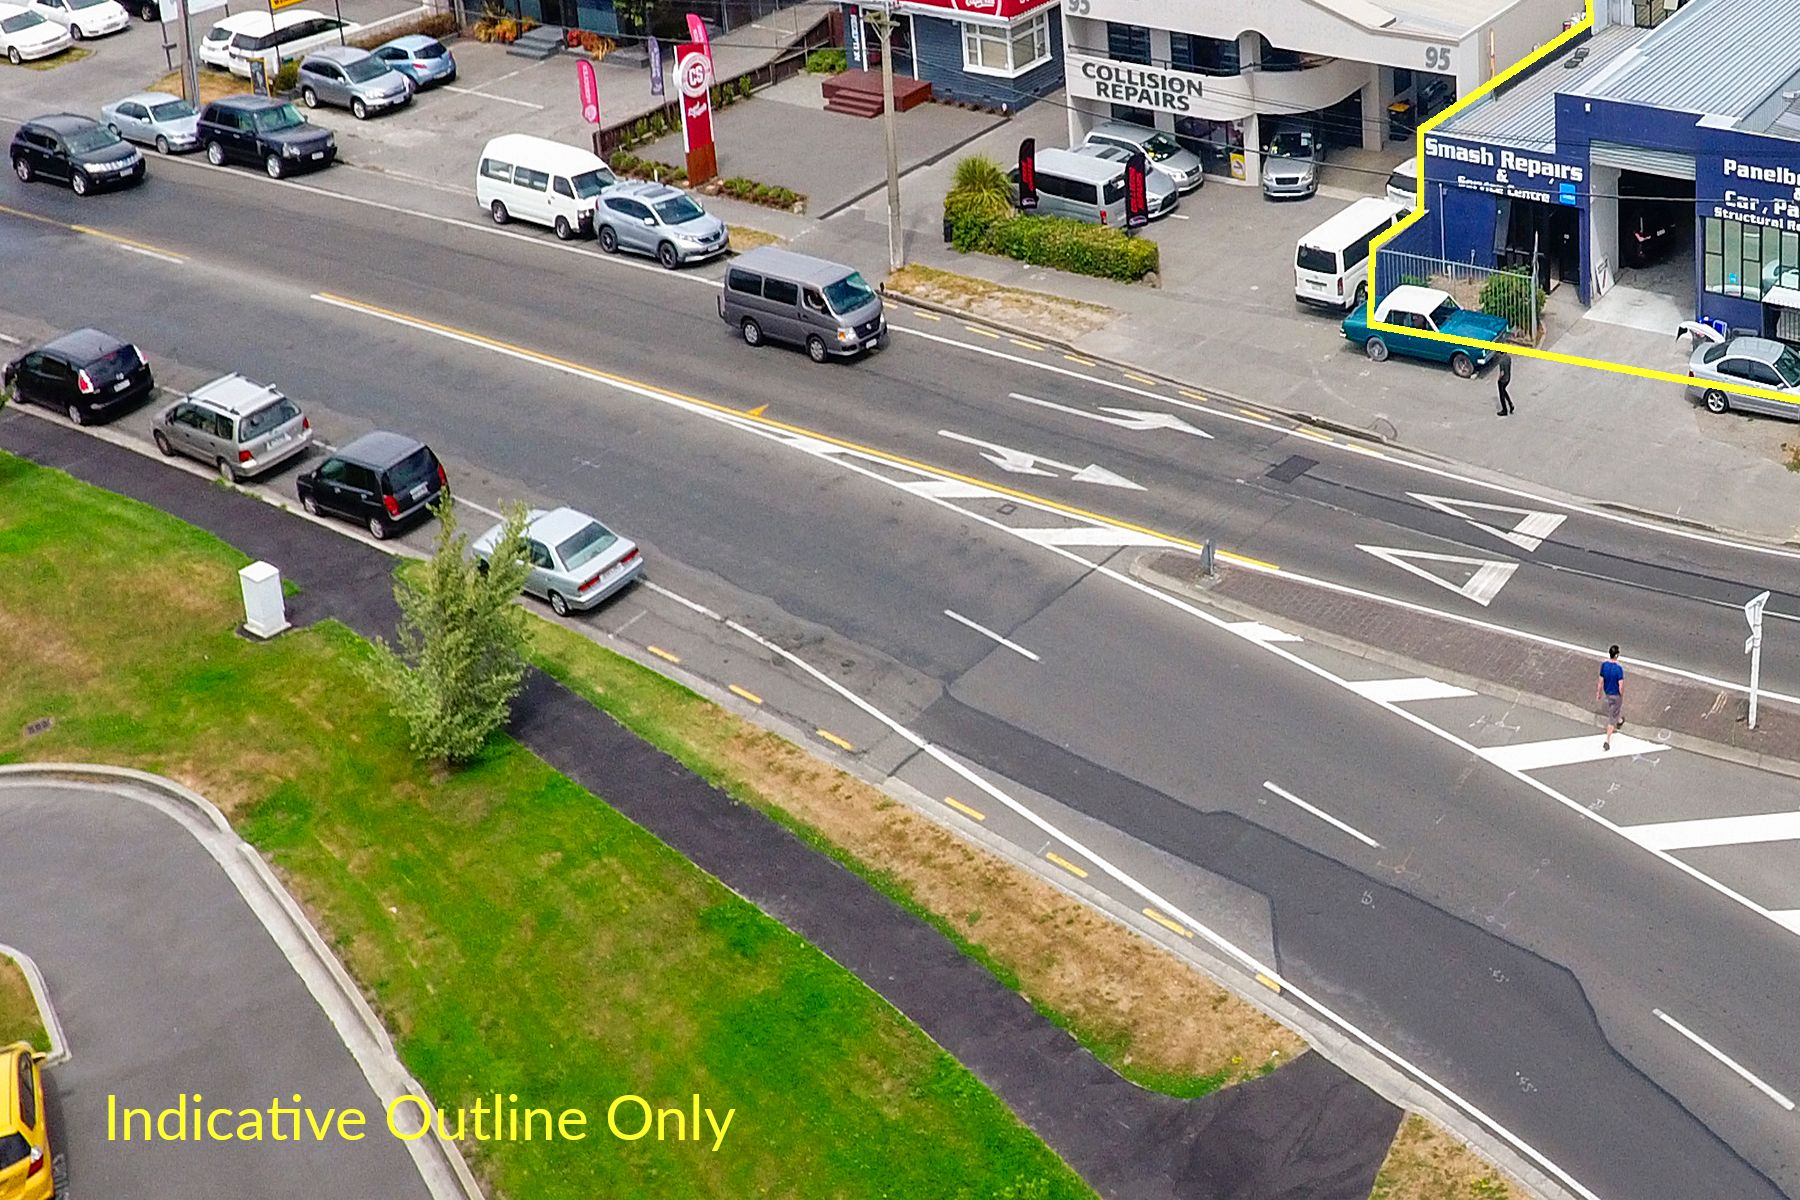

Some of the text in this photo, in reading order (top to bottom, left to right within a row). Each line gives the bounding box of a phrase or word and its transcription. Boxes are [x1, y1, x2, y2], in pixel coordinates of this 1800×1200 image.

[1425, 46, 1451, 71] 95
[689, 65, 703, 86] CS
[1081, 62, 1203, 97] COLLISION
[1095, 81, 1190, 112] REPAIRS
[1425, 137, 1584, 183] Smash Repairs
[1496, 168, 1509, 184] &
[1713, 206, 1784, 229] Structural
